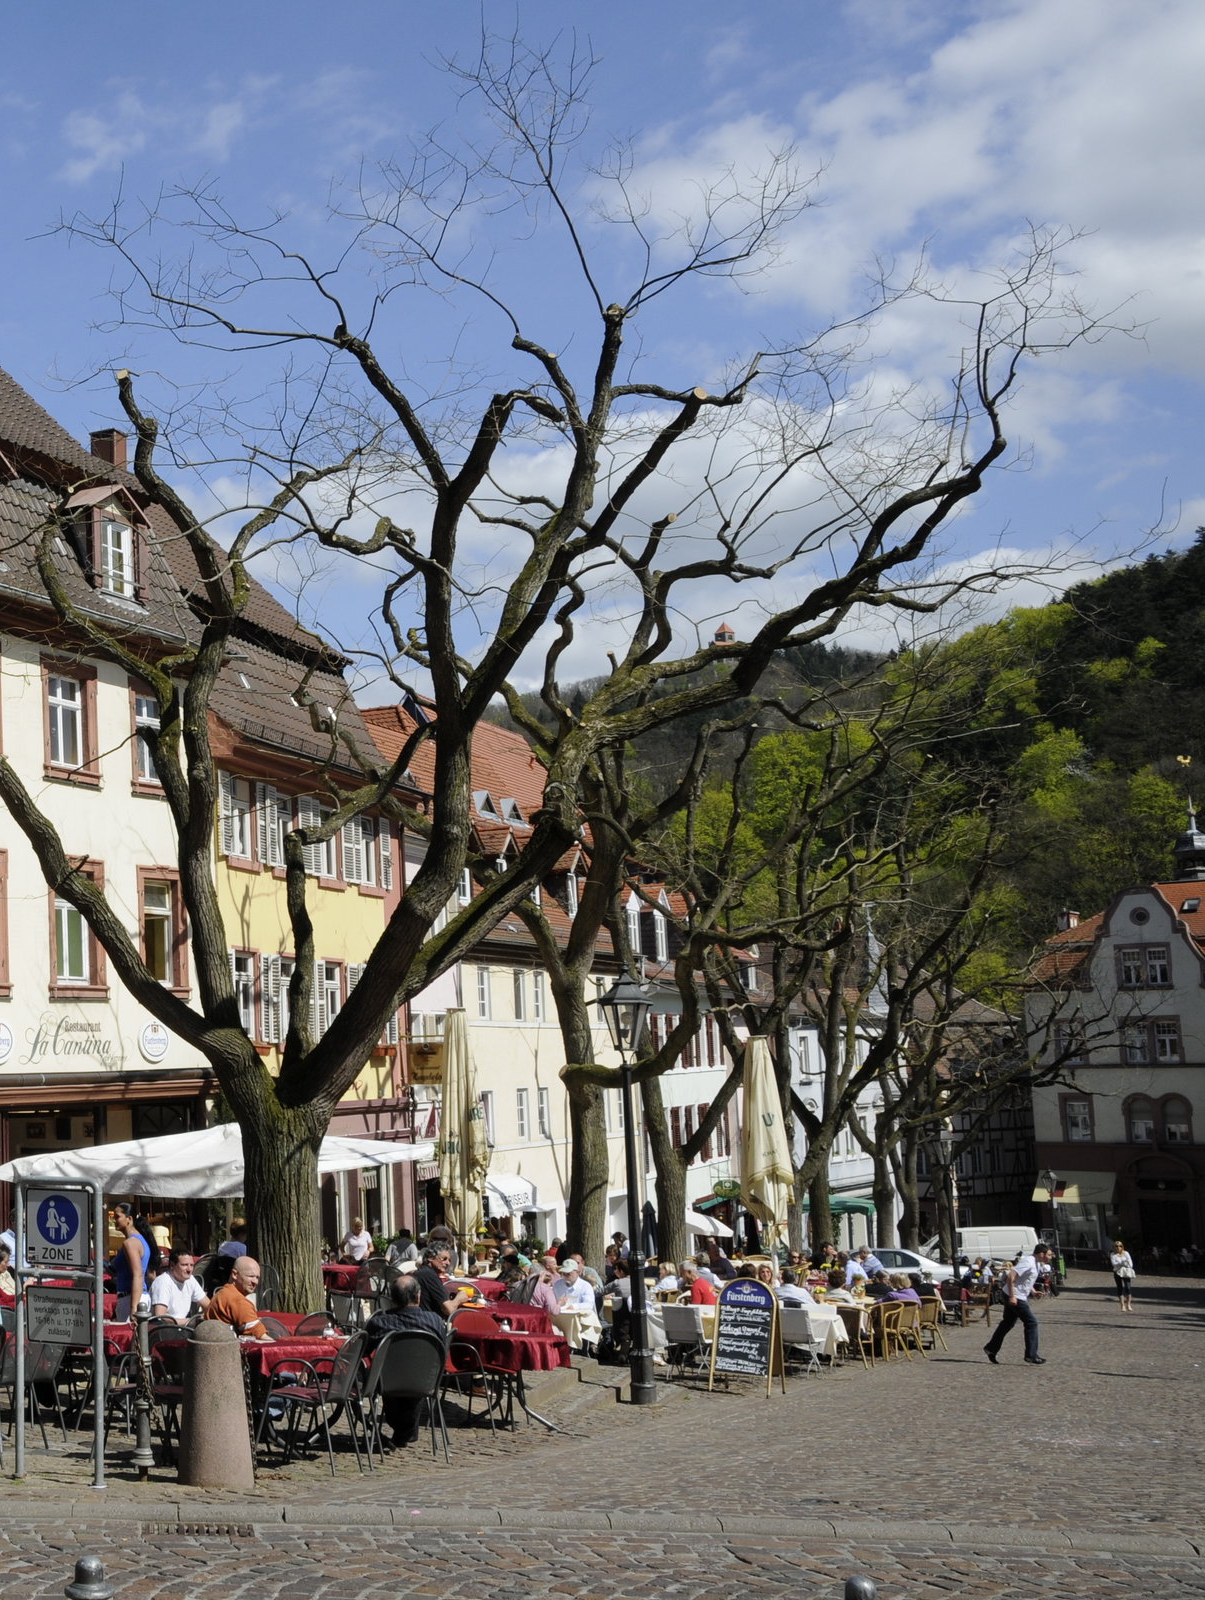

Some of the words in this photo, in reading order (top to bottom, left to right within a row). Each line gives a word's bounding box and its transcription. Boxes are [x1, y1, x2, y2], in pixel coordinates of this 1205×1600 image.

[64, 1020, 102, 1033] Restaurant
[19, 1023, 48, 1064] La
[49, 1015, 112, 1056] Cantina
[42, 1247, 74, 1261] ZONE
[33, 1294, 73, 1304] Straßenmusik
[34, 1306, 61, 1315] werktags
[48, 1327, 71, 1337] zulässig
